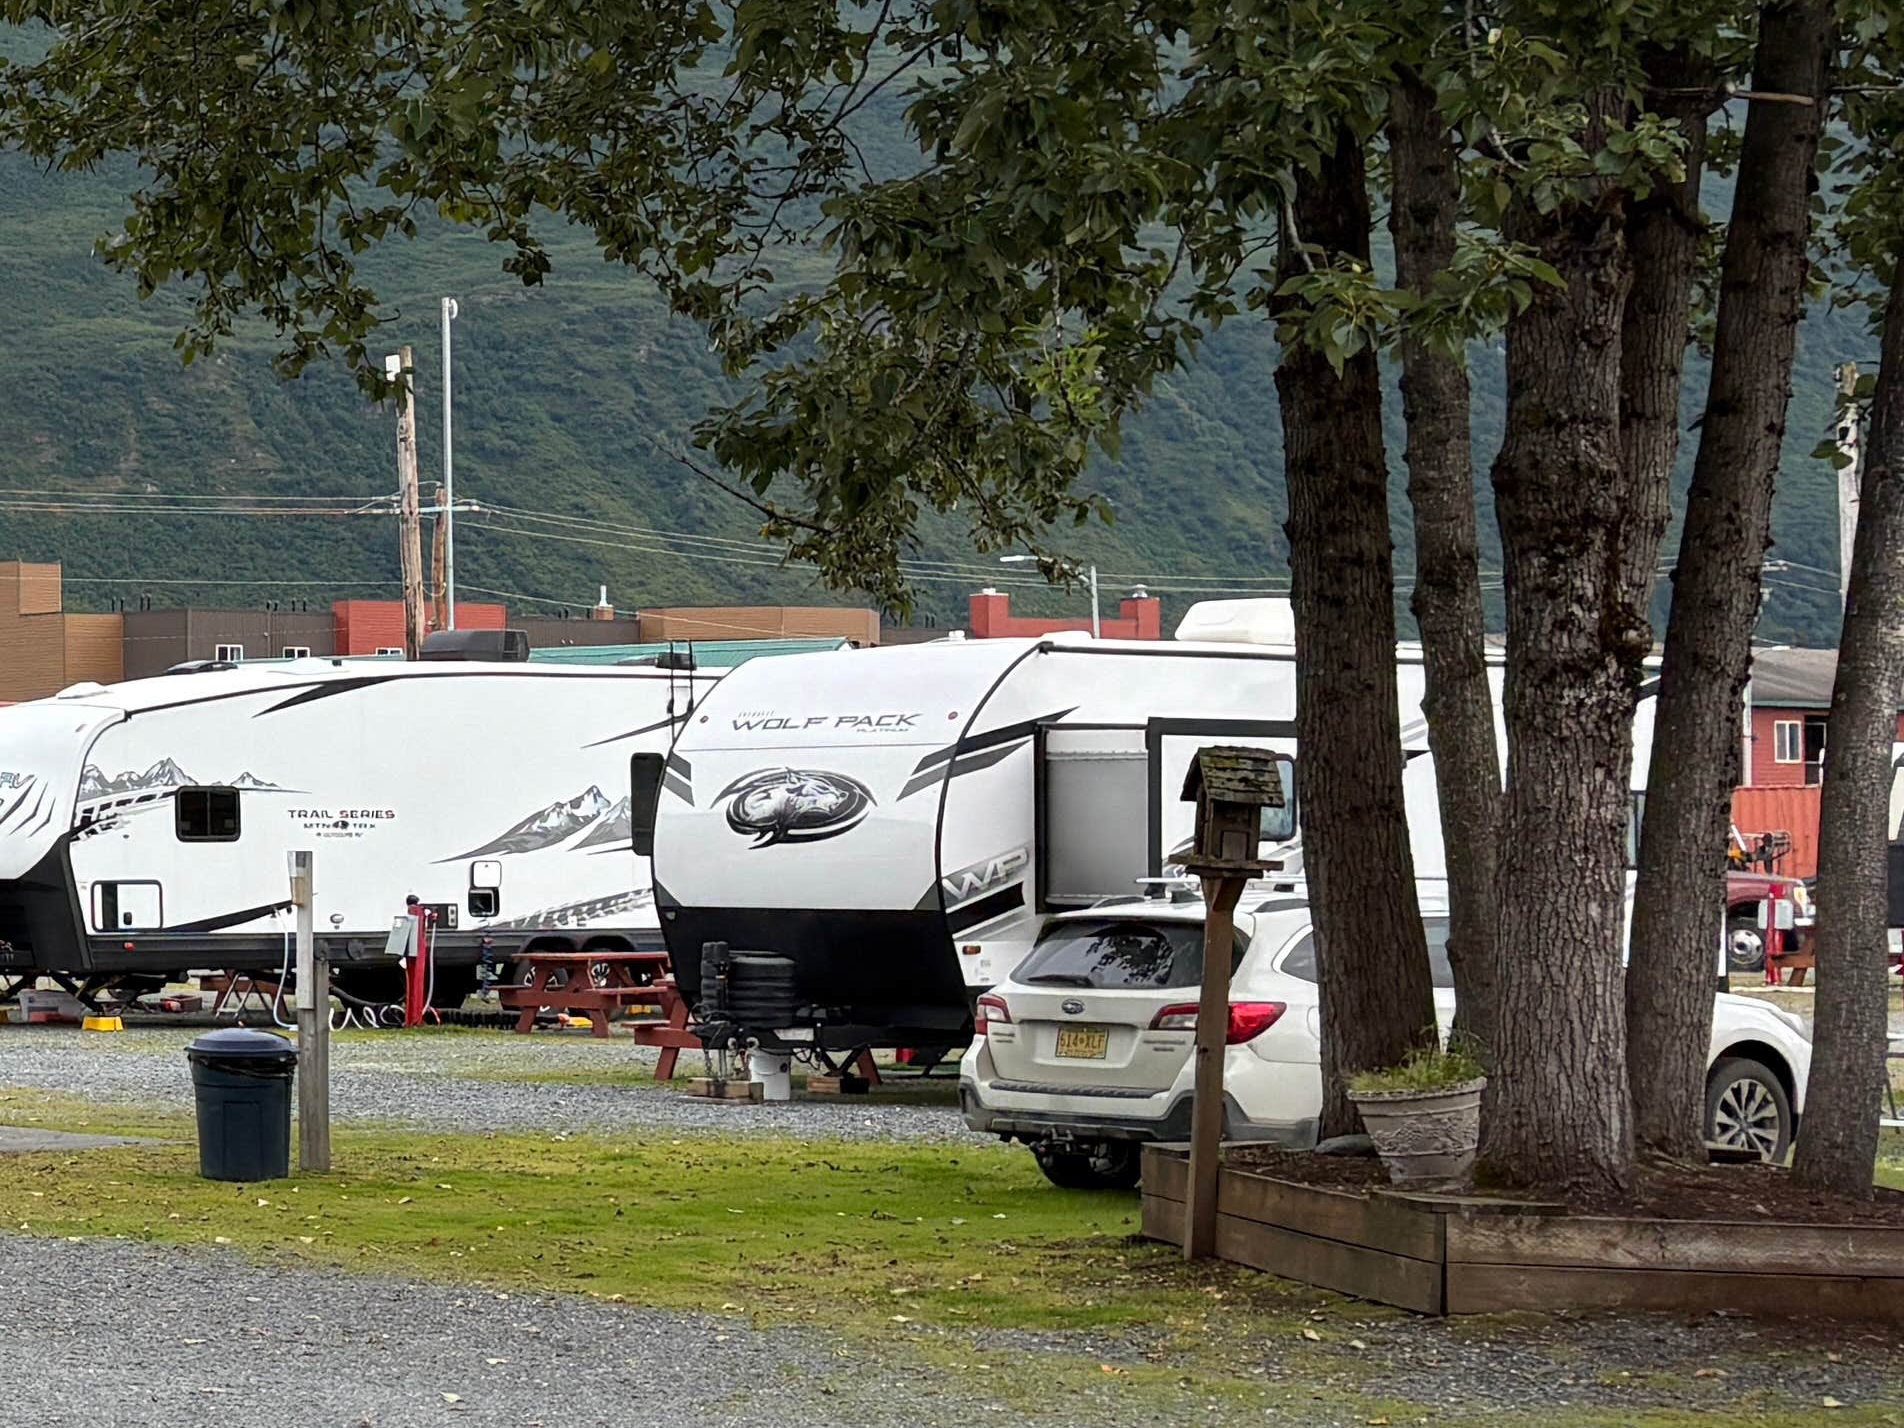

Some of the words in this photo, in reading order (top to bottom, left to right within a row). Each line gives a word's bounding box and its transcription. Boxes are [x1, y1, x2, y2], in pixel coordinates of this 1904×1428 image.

[732, 717, 829, 731] WOLF
[834, 713, 923, 728] PACK
[288, 809, 333, 819] TRAIL
[339, 810, 395, 819] SERIES
